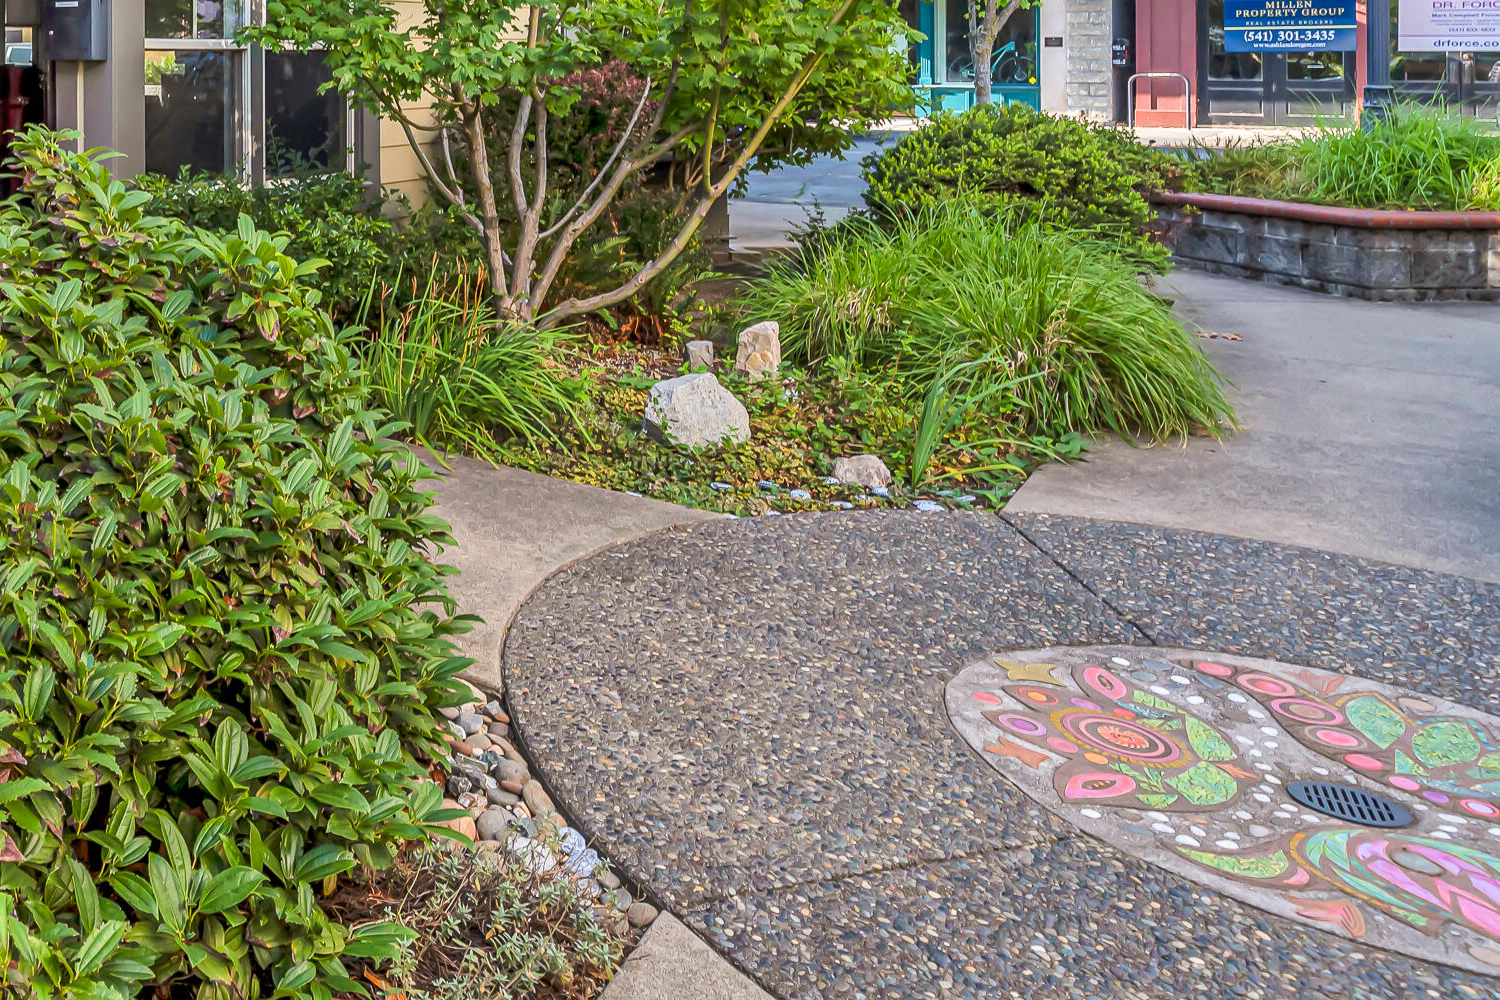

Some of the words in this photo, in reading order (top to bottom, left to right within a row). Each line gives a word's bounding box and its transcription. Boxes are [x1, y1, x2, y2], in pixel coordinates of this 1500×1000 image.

[1266, 0, 1312, 9] MILLEN
[1235, 8, 1297, 17] PROPERTY
[1301, 7, 1345, 16] GROUP
[1244, 31, 1273, 42] (541)
[1277, 30, 1335, 41] 301-3435
